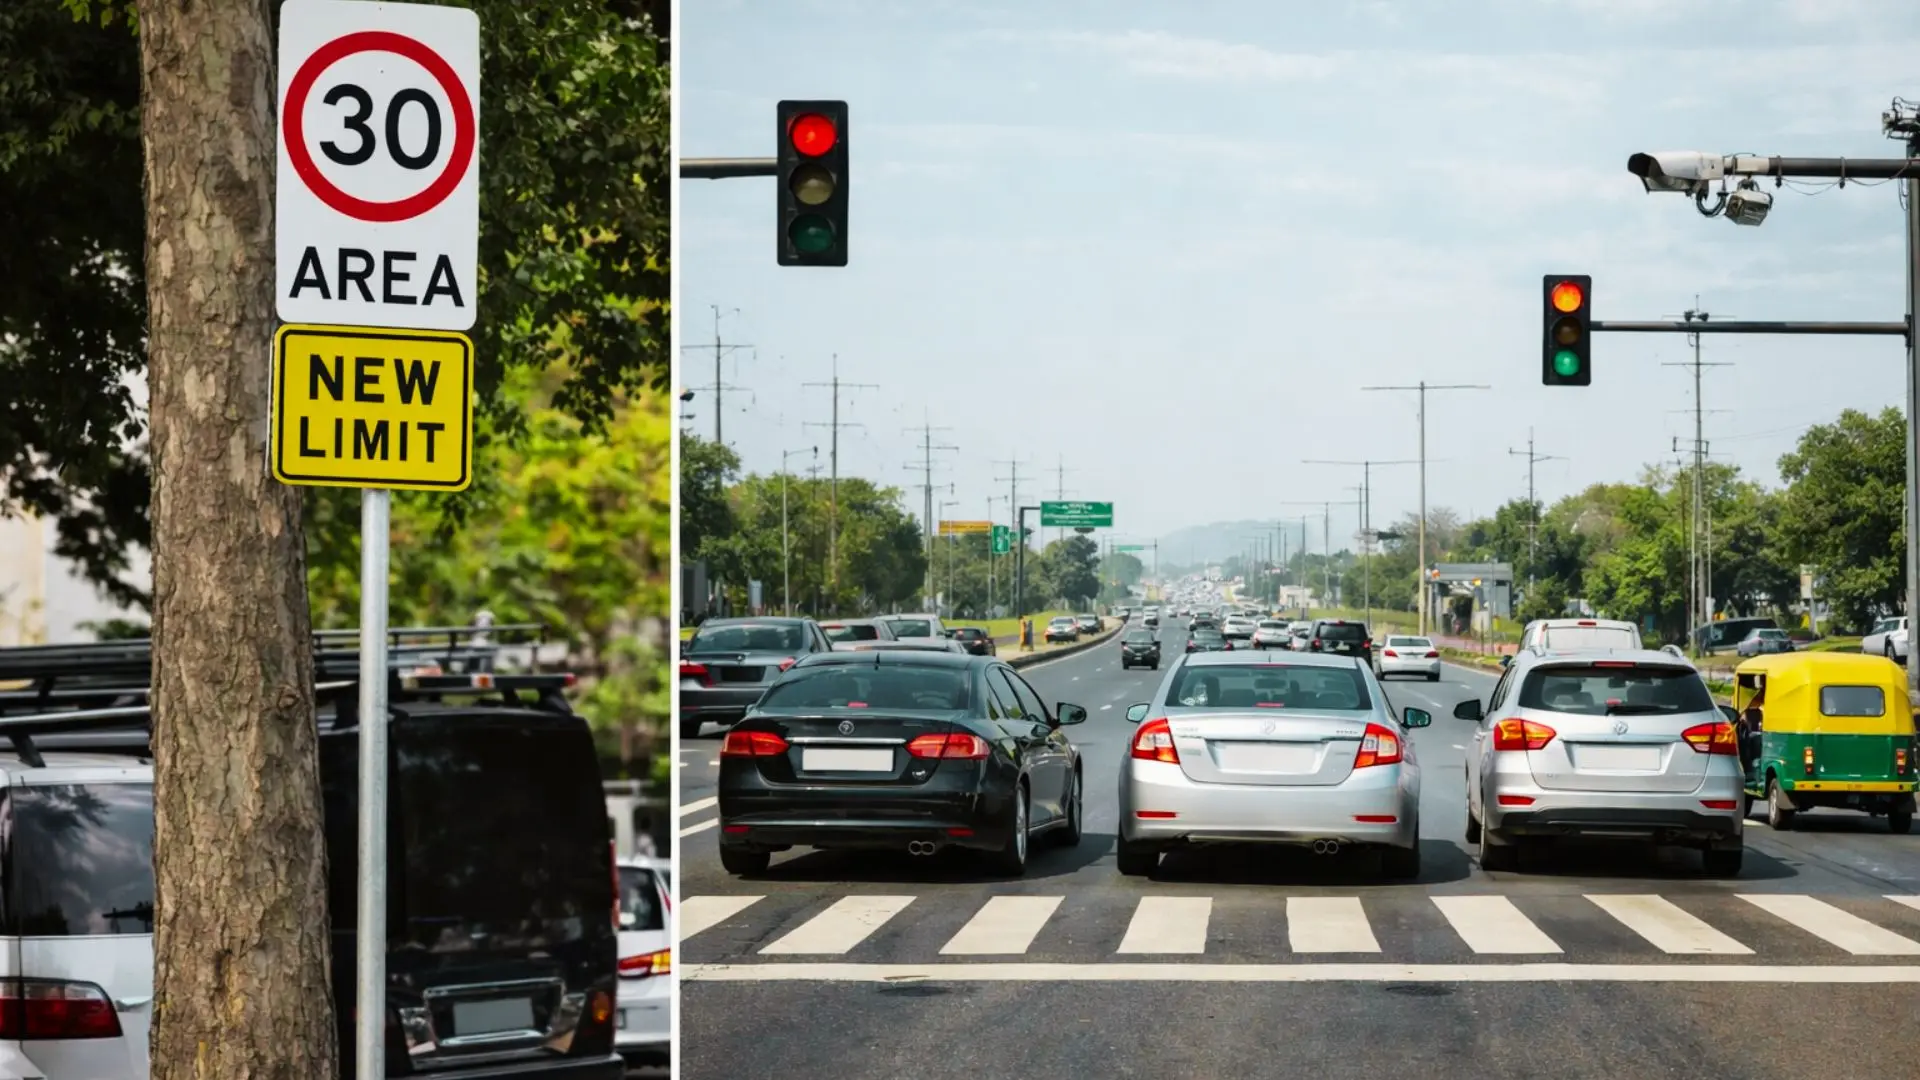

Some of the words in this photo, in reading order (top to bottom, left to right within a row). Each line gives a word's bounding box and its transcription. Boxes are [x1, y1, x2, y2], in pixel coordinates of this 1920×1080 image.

[319, 83, 442, 170] 30
[289, 246, 465, 308] AREA
[309, 354, 441, 406] NEW
[299, 415, 445, 463] LIMIT
